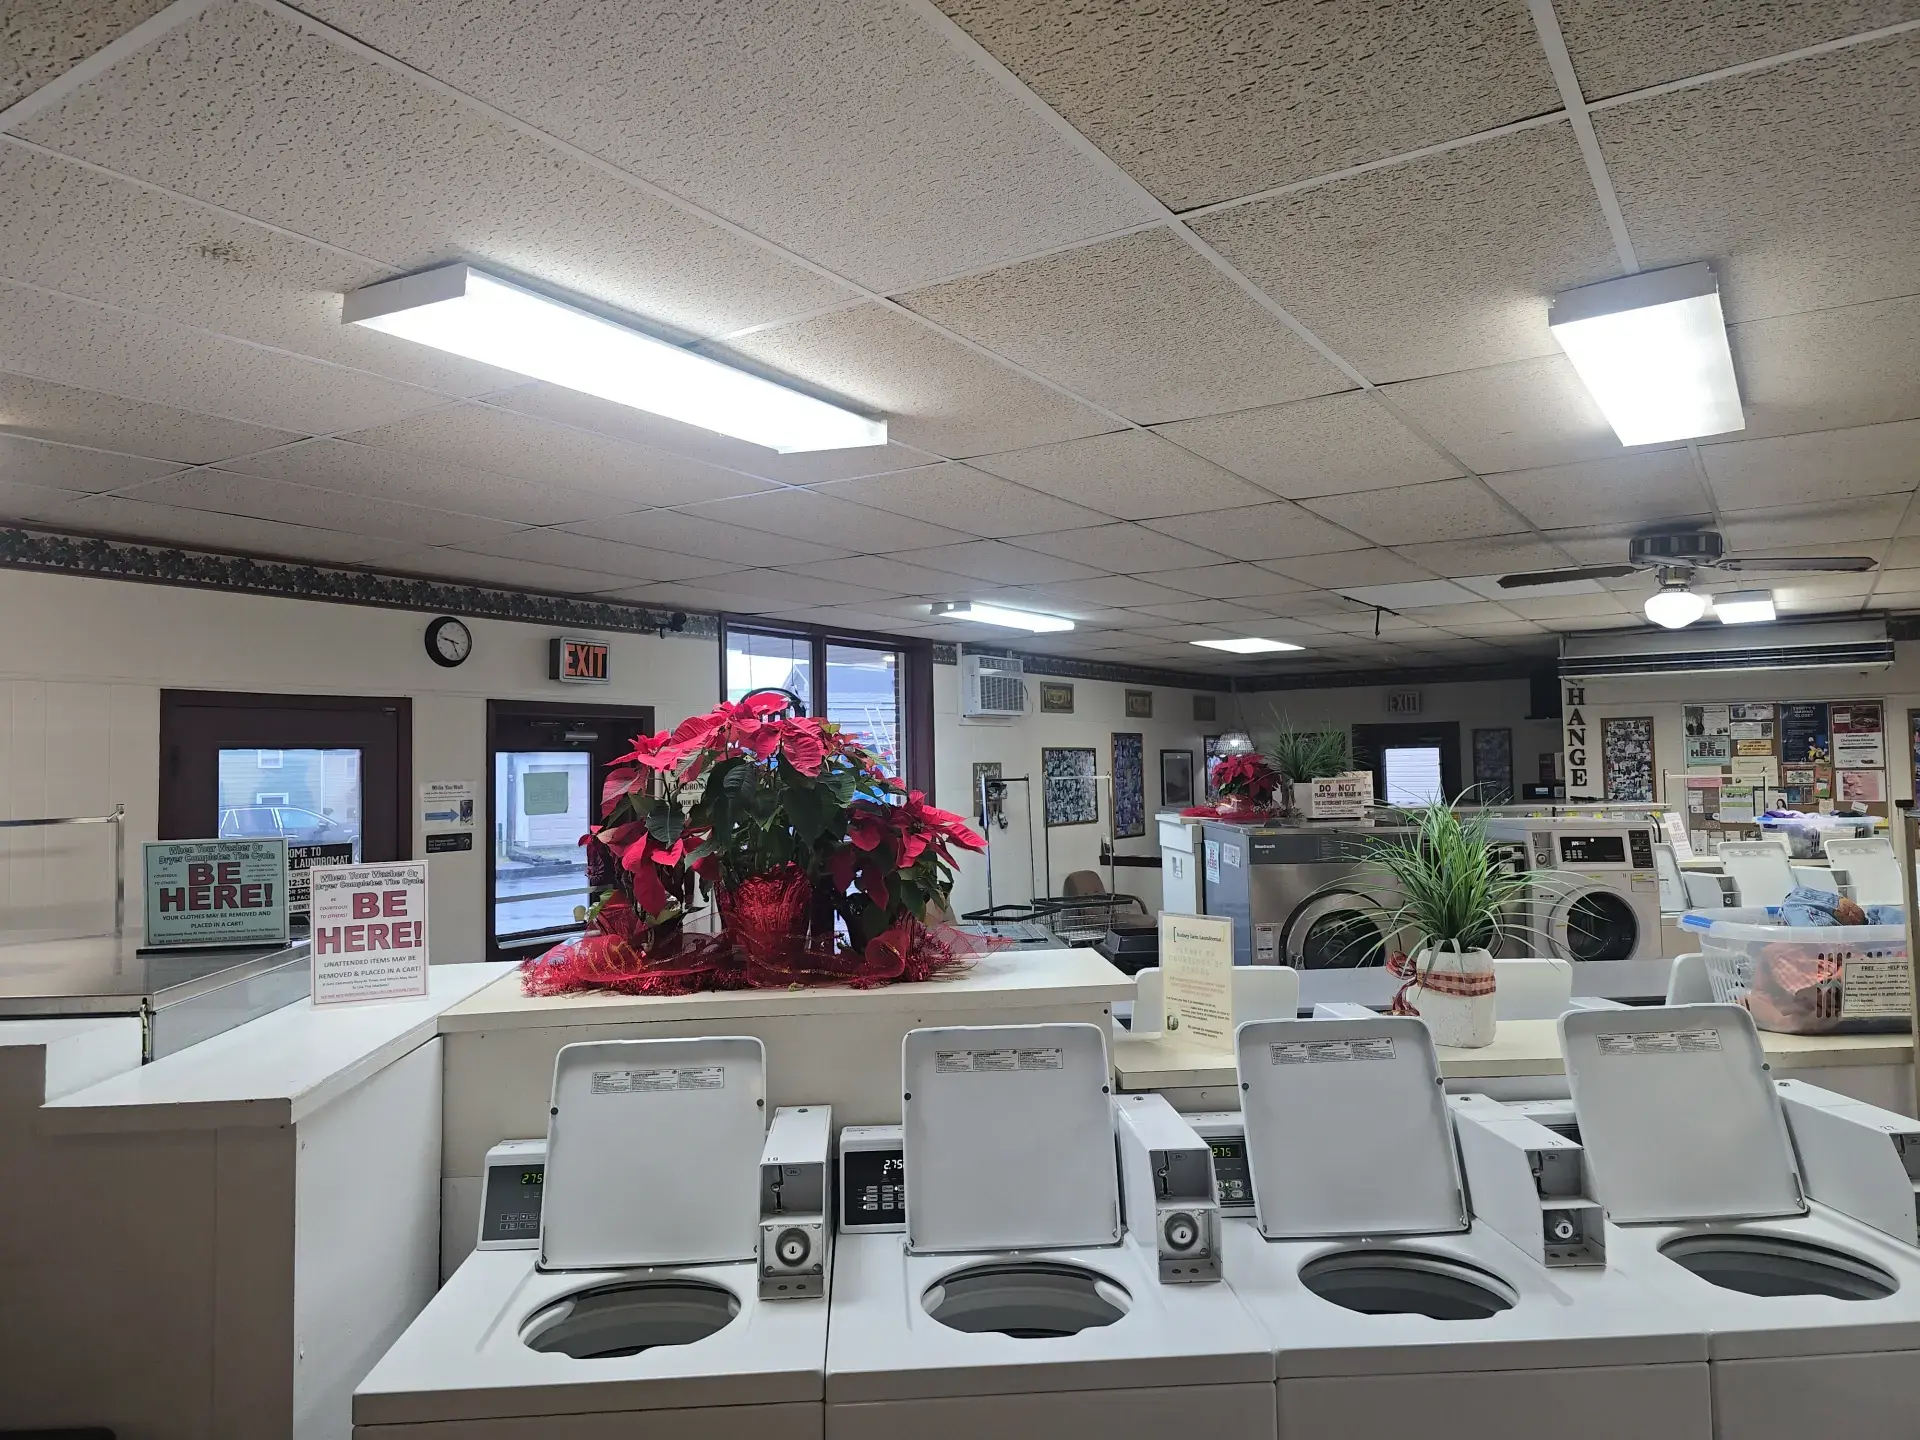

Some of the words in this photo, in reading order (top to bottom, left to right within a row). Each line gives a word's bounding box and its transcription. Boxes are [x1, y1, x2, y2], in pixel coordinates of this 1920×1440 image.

[565, 643, 607, 678] EXIT
[1390, 694, 1415, 711] EXIT
[1691, 749, 1726, 757] HERE!
[1319, 784, 1331, 792] DO
[169, 845, 195, 855] When
[196, 844, 216, 853] Your
[219, 843, 250, 852] Washer
[252, 843, 263, 851] Or
[288, 848, 308, 858] OME
[311, 847, 321, 856] TO
[159, 855, 182, 865] Dryer
[185, 852, 230, 863] Completes
[233, 851, 250, 860] The
[251, 851, 276, 861] Cycle
[294, 855, 349, 868] LAUNDROMAT
[188, 862, 242, 887] BE
[320, 873, 346, 883] When
[348, 871, 369, 880] Your
[372, 870, 405, 878] Washer
[407, 869, 418, 877] Or
[315, 882, 339, 891] Dryer
[340, 879, 383, 889] Completes
[402, 878, 424, 886] Cycle
[159, 883, 274, 913] HERE!
[352, 890, 408, 919] BE
[317, 921, 422, 954] HERE!
[324, 959, 369, 968] UNATTENDED
[318, 971, 352, 980] REMOVED
